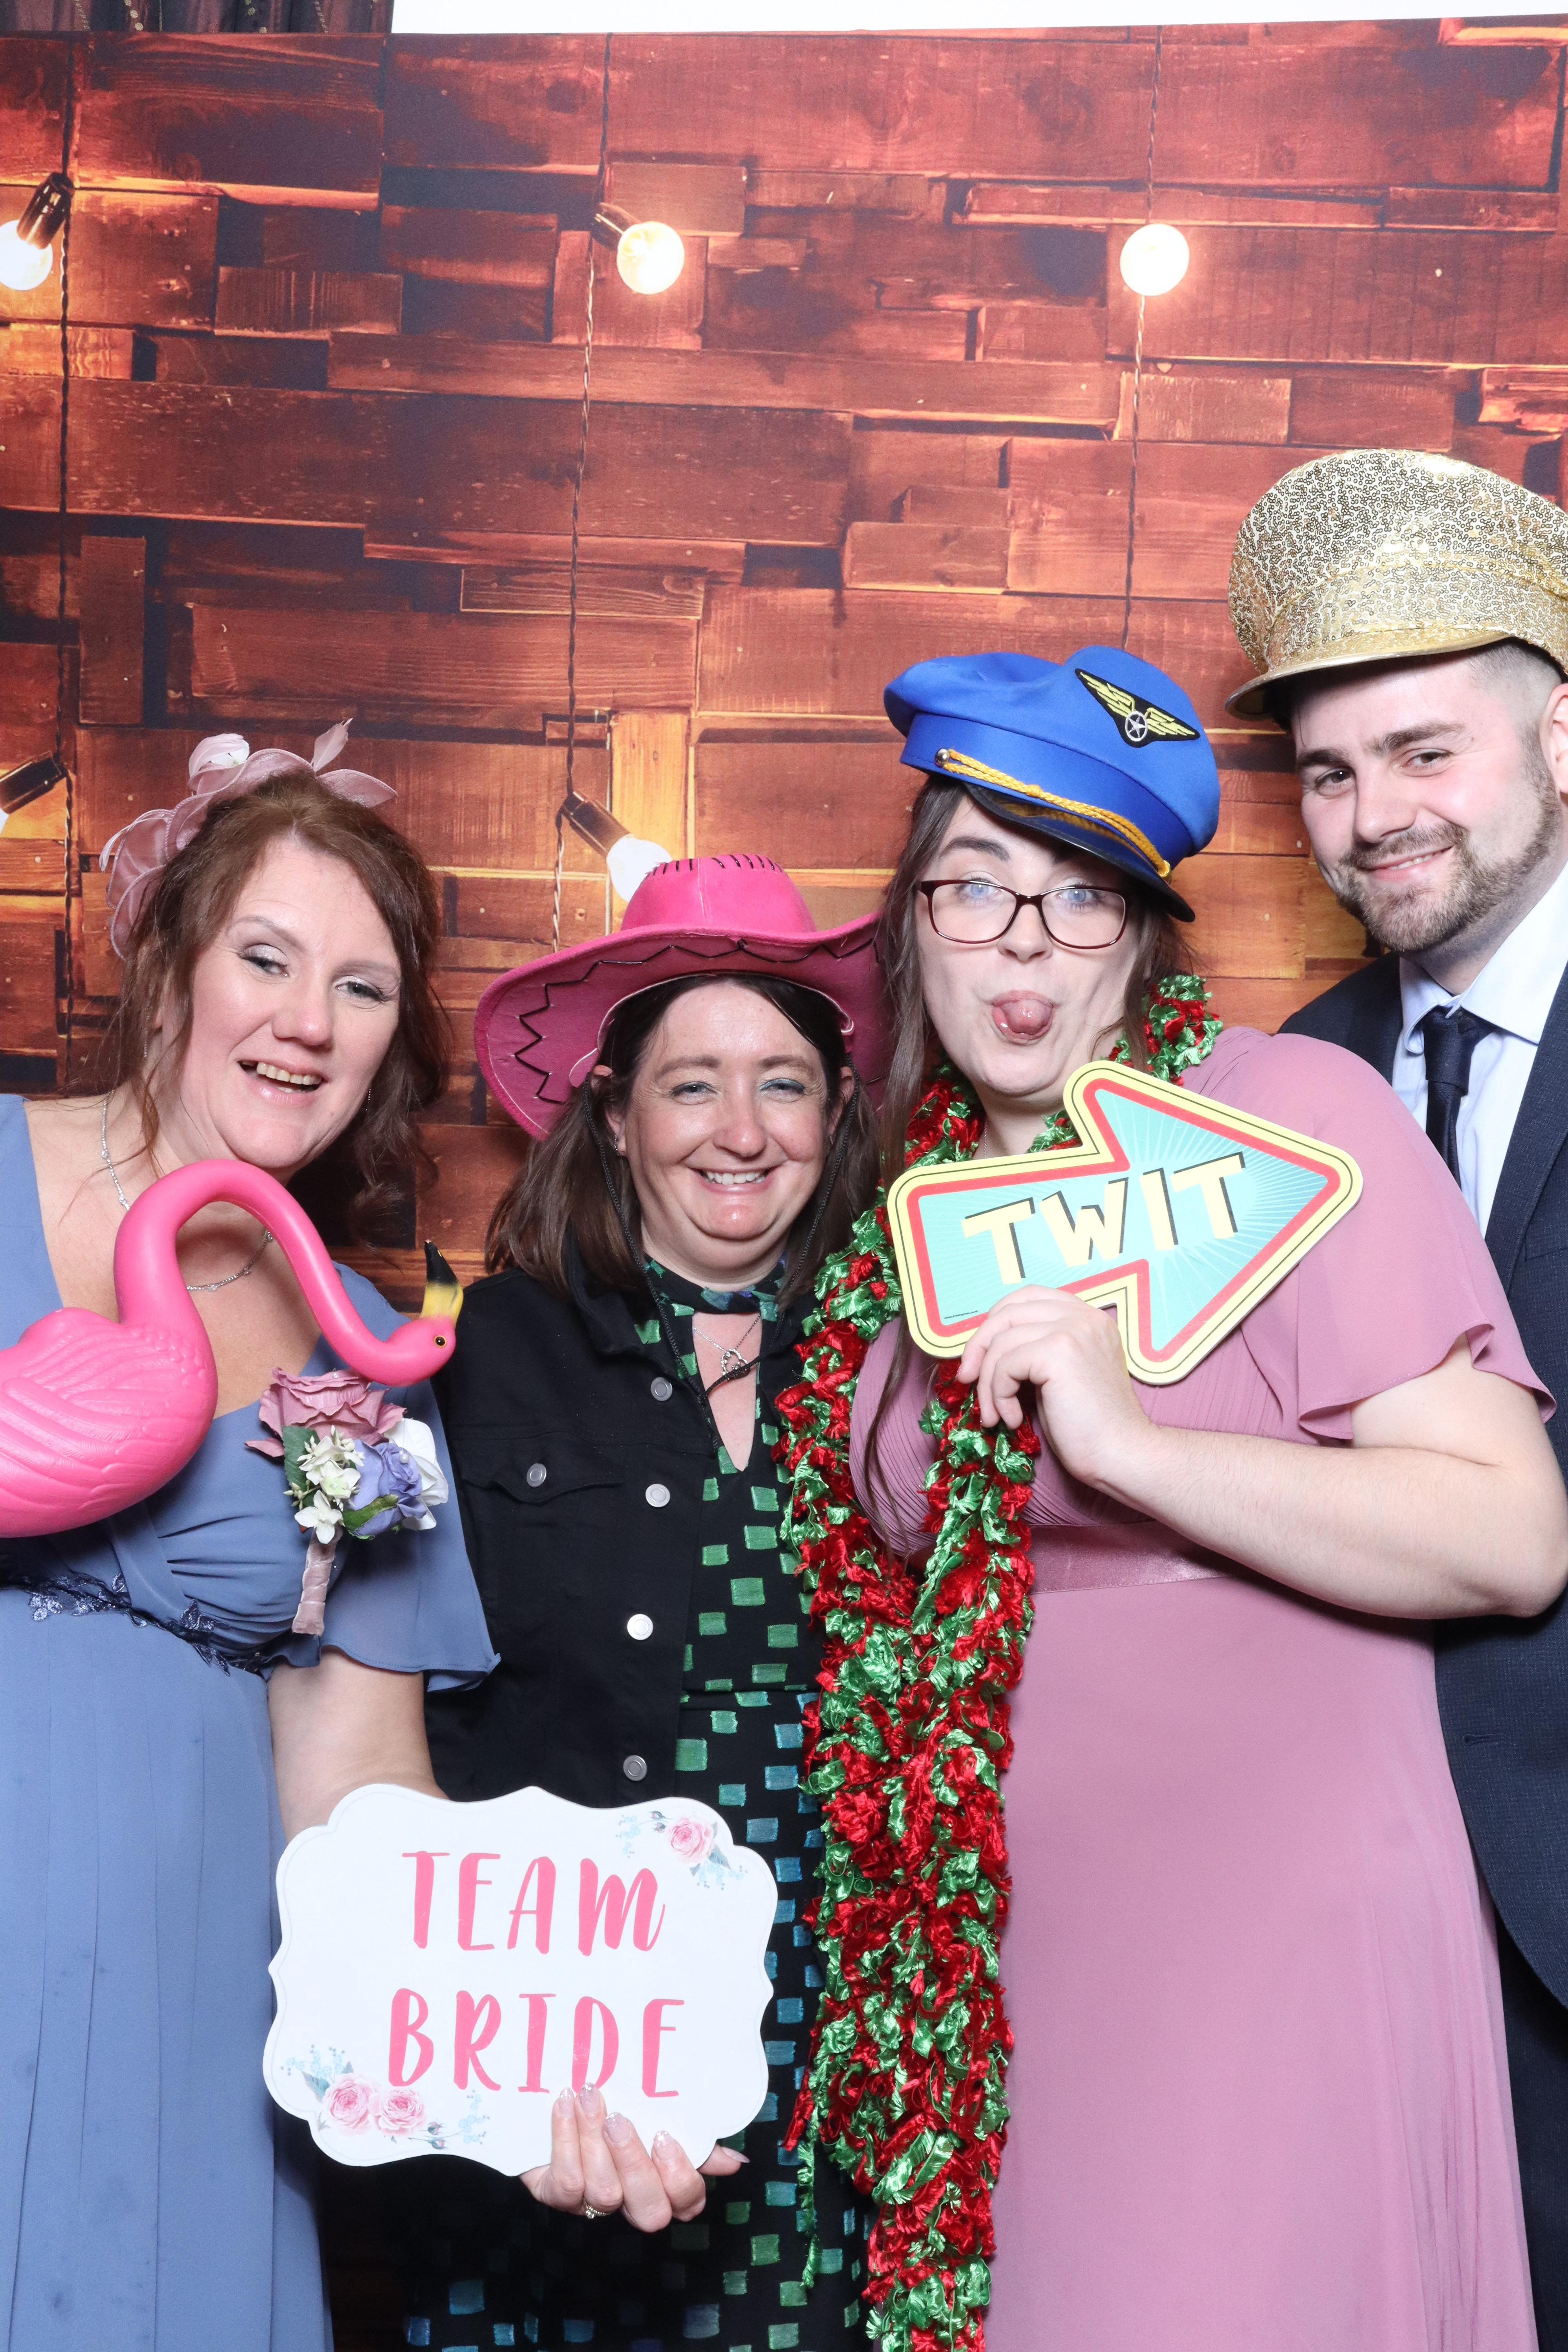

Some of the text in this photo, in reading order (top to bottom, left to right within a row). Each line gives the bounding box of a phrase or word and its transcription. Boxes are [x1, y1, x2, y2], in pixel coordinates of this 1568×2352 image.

[961, 1151, 1246, 1284] TWIT
[403, 1851, 666, 1956] TEAM
[388, 1988, 684, 2098] BRIDE
